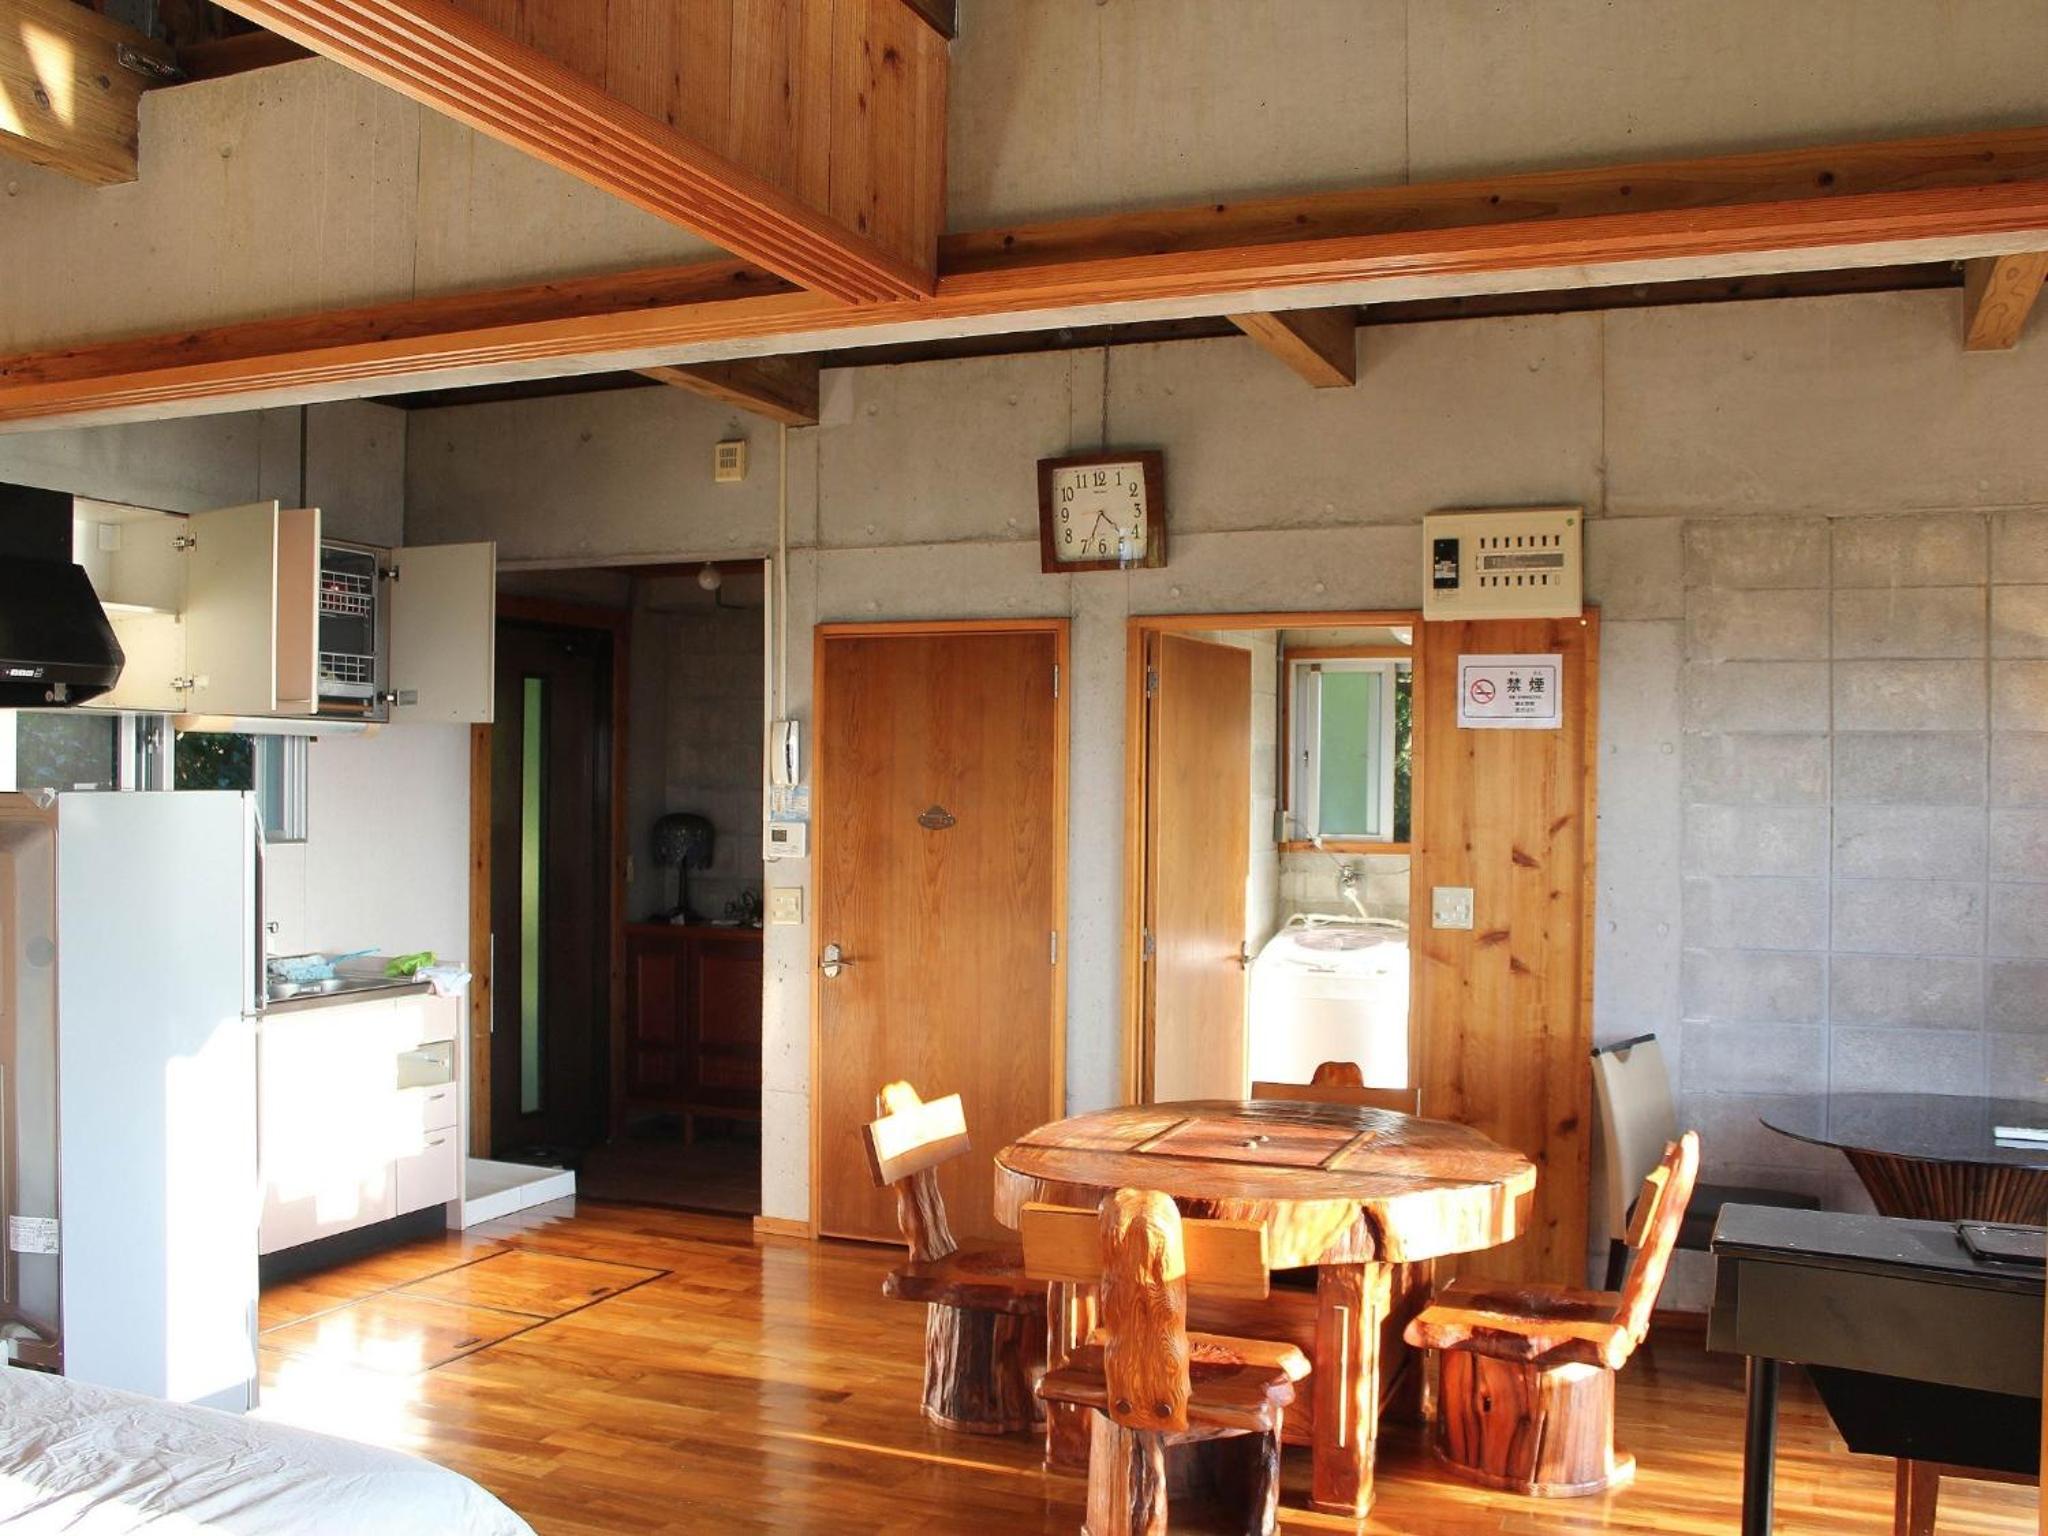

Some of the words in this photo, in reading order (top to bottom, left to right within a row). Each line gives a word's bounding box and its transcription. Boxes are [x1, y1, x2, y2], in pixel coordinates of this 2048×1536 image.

[1076, 474, 1087, 489] 11
[1093, 471, 1107, 486] 12
[1115, 471, 1122, 486] 1
[1062, 486, 1074, 502] 10
[1129, 481, 1138, 497] 2
[1061, 507, 1069, 523] 9
[1134, 503, 1141, 518] 3
[1064, 528, 1072, 544] 8
[1131, 524, 1140, 539] 4
[1081, 539, 1088, 554] 7
[1098, 539, 1106, 554] 6
[1118, 536, 1126, 552] 5
[1506, 677, 1545, 693] 禁煙
